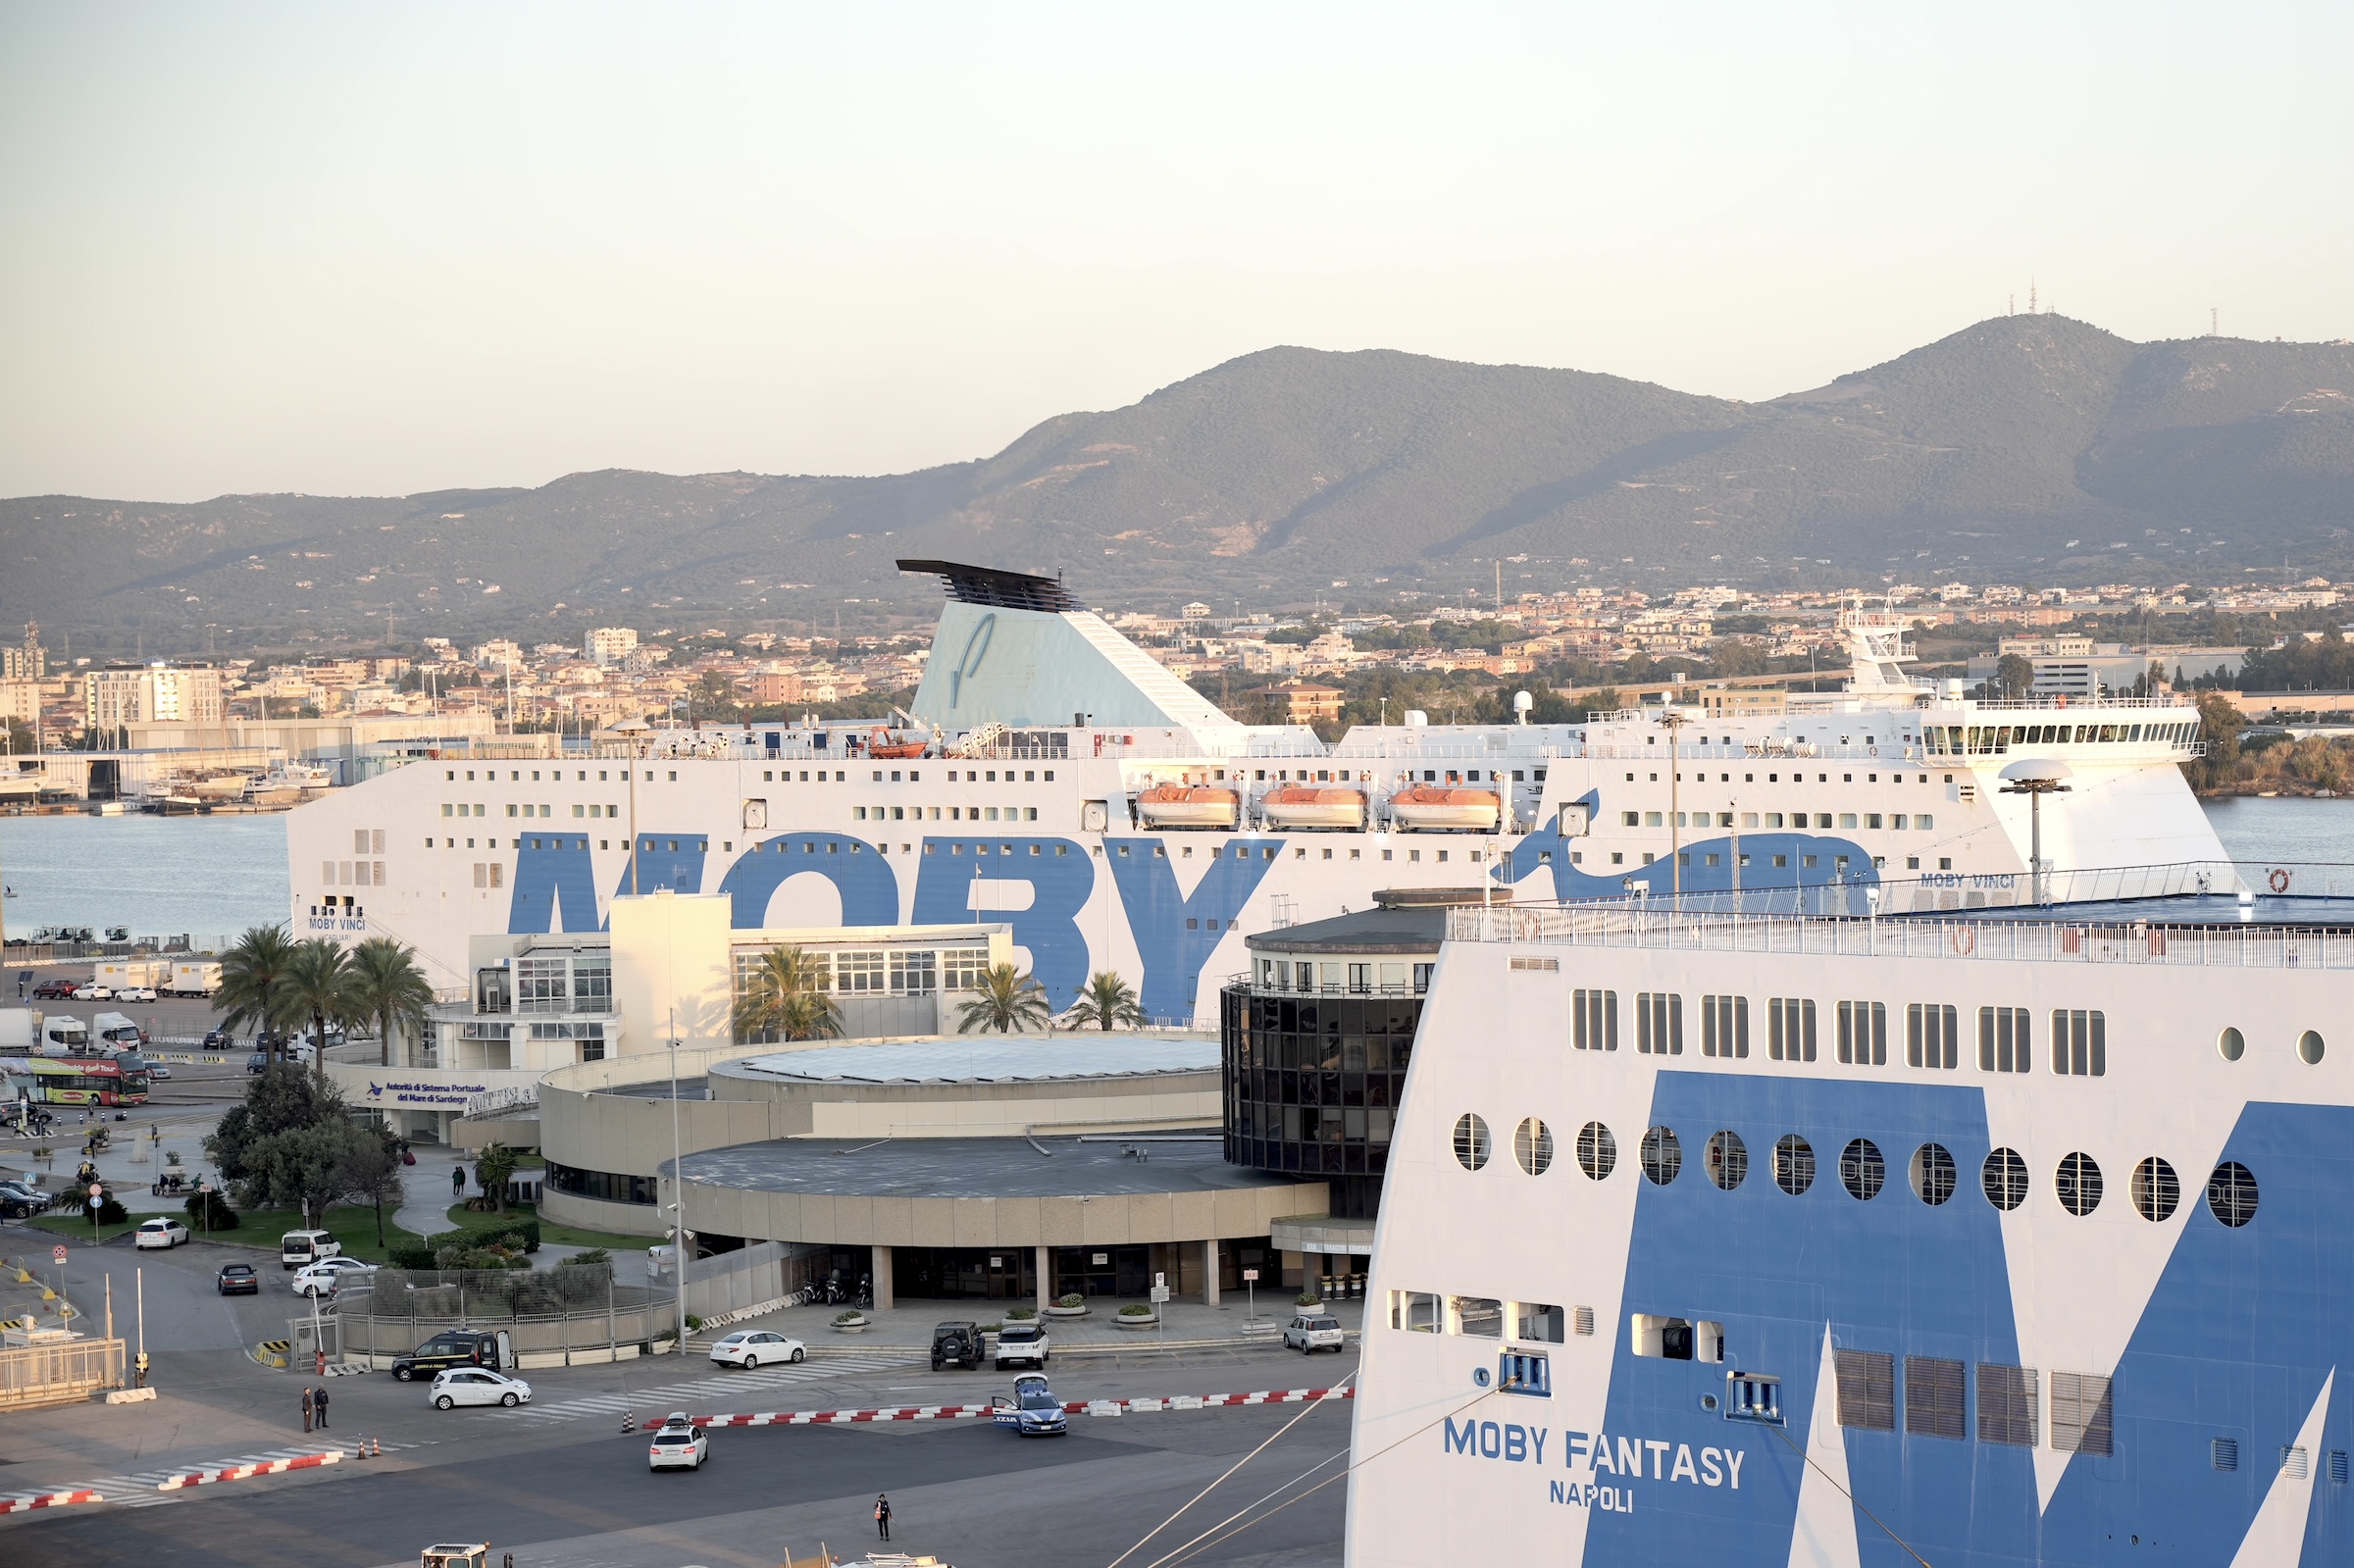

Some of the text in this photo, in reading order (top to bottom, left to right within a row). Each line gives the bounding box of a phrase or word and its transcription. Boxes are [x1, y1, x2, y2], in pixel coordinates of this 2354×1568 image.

[1920, 873, 2016, 889] MOBY VINCI
[309, 918, 366, 931] MOBY VINCI
[100, 1064, 117, 1073] Tour
[386, 1082, 413, 1090] Autorità
[422, 1084, 450, 1092] Sistema
[452, 1084, 486, 1092] Portuale
[435, 1095, 467, 1105] Sardegn
[1444, 1416, 1745, 1490] MOBY FANTASY
[1550, 1479, 1634, 1514] NAPOLI
